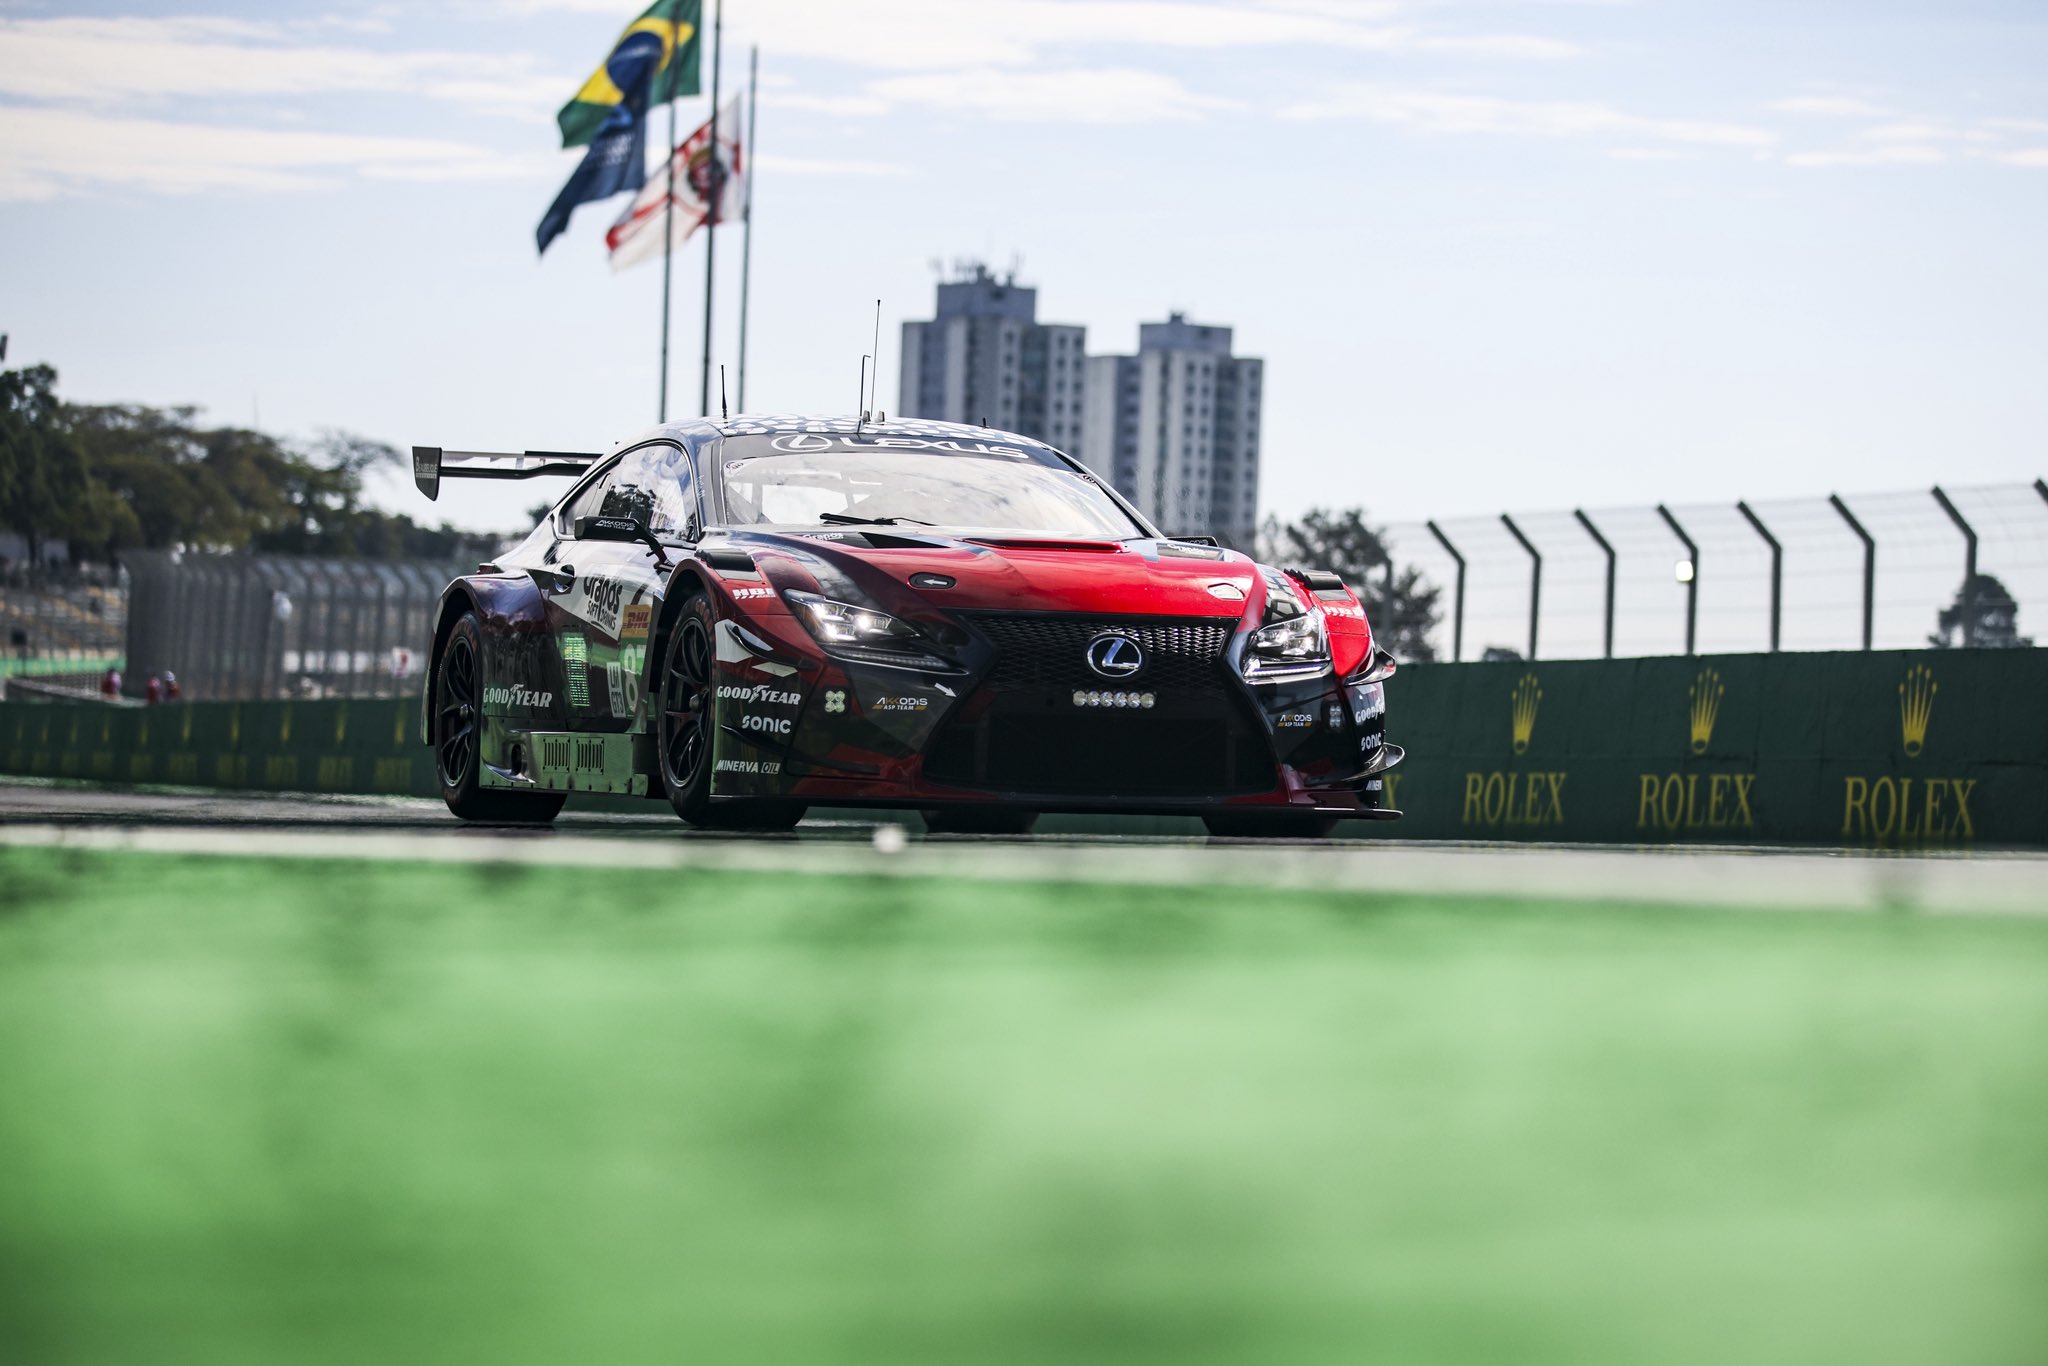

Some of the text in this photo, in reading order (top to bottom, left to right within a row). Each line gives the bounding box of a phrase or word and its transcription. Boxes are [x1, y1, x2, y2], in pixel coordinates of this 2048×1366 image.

[840, 437, 1030, 459] LEXUS
[716, 759, 781, 774] MINERVA OIL
[1461, 771, 1567, 825] ROLEX
[1637, 772, 1756, 828] ROLEX
[1842, 775, 1977, 838] ROLEX
